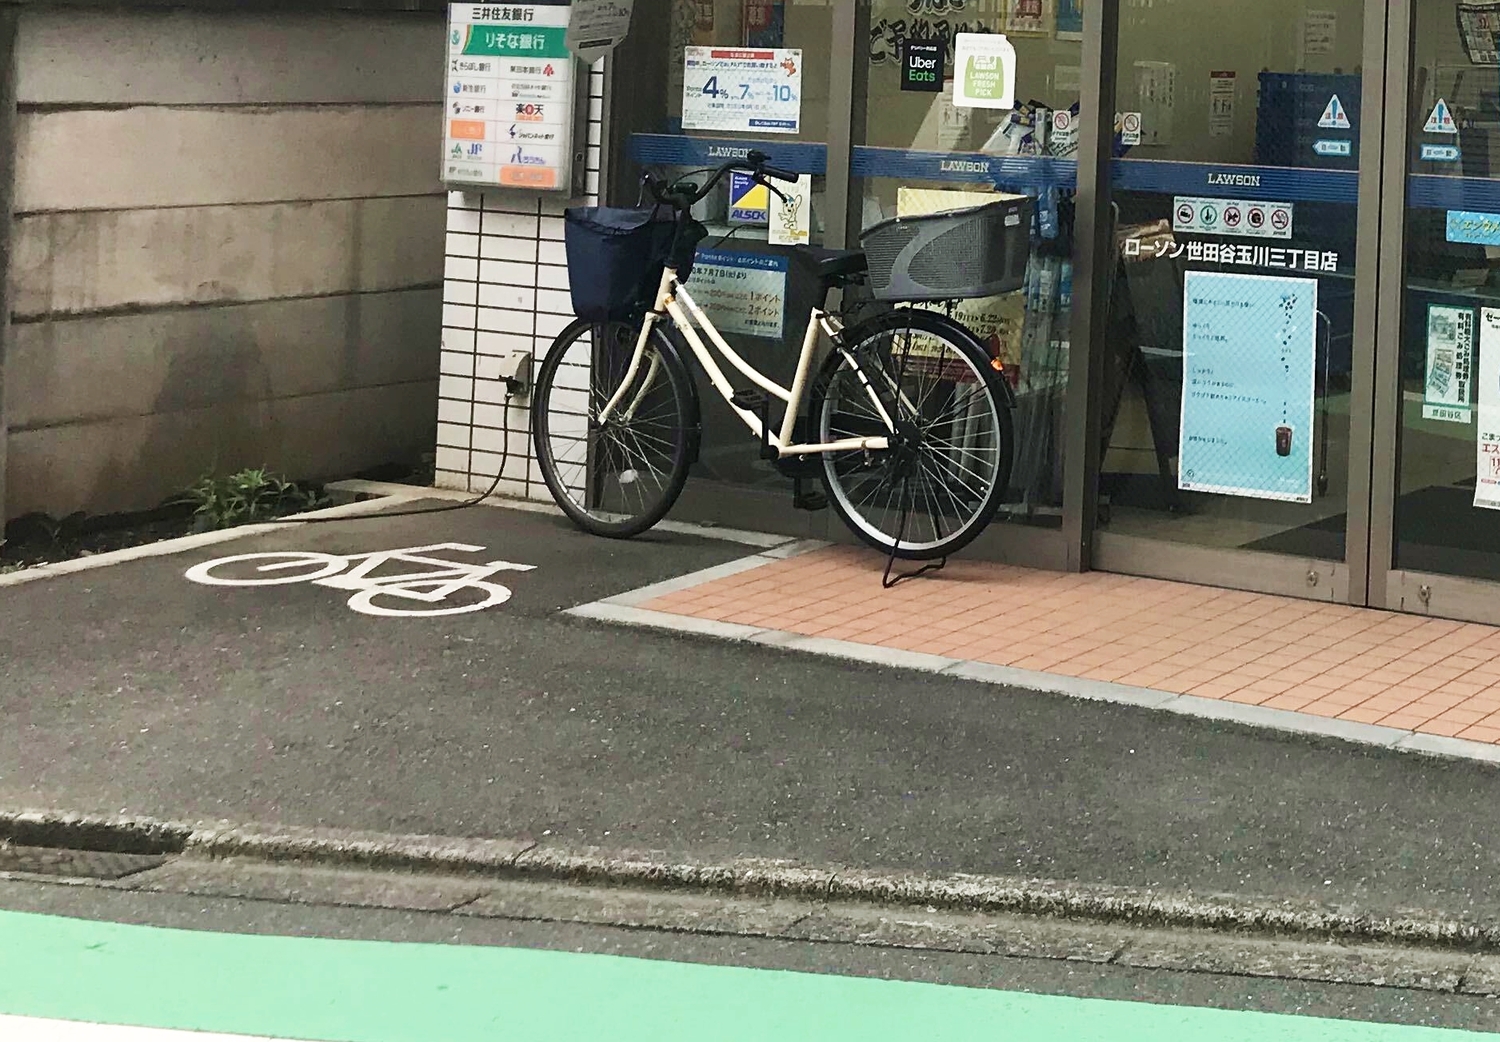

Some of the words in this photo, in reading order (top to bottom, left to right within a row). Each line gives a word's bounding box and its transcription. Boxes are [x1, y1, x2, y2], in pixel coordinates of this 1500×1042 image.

[471, 7, 534, 22] 三井住友銀行
[485, 33, 545, 50] りそな銀行
[909, 56, 937, 69] Uber
[909, 69, 936, 81] Eats
[969, 72, 999, 80] LAWSON
[972, 80, 996, 88] FRESH
[975, 88, 992, 96] PICK
[940, 160, 989, 173] LAWSON
[1207, 173, 1261, 187] LAWSON
[732, 210, 766, 220] ALSOK
[1124, 237, 1339, 272] ローソン世田谷玉川三丁目店
[1432, 409, 1462, 420] 世田谷区
